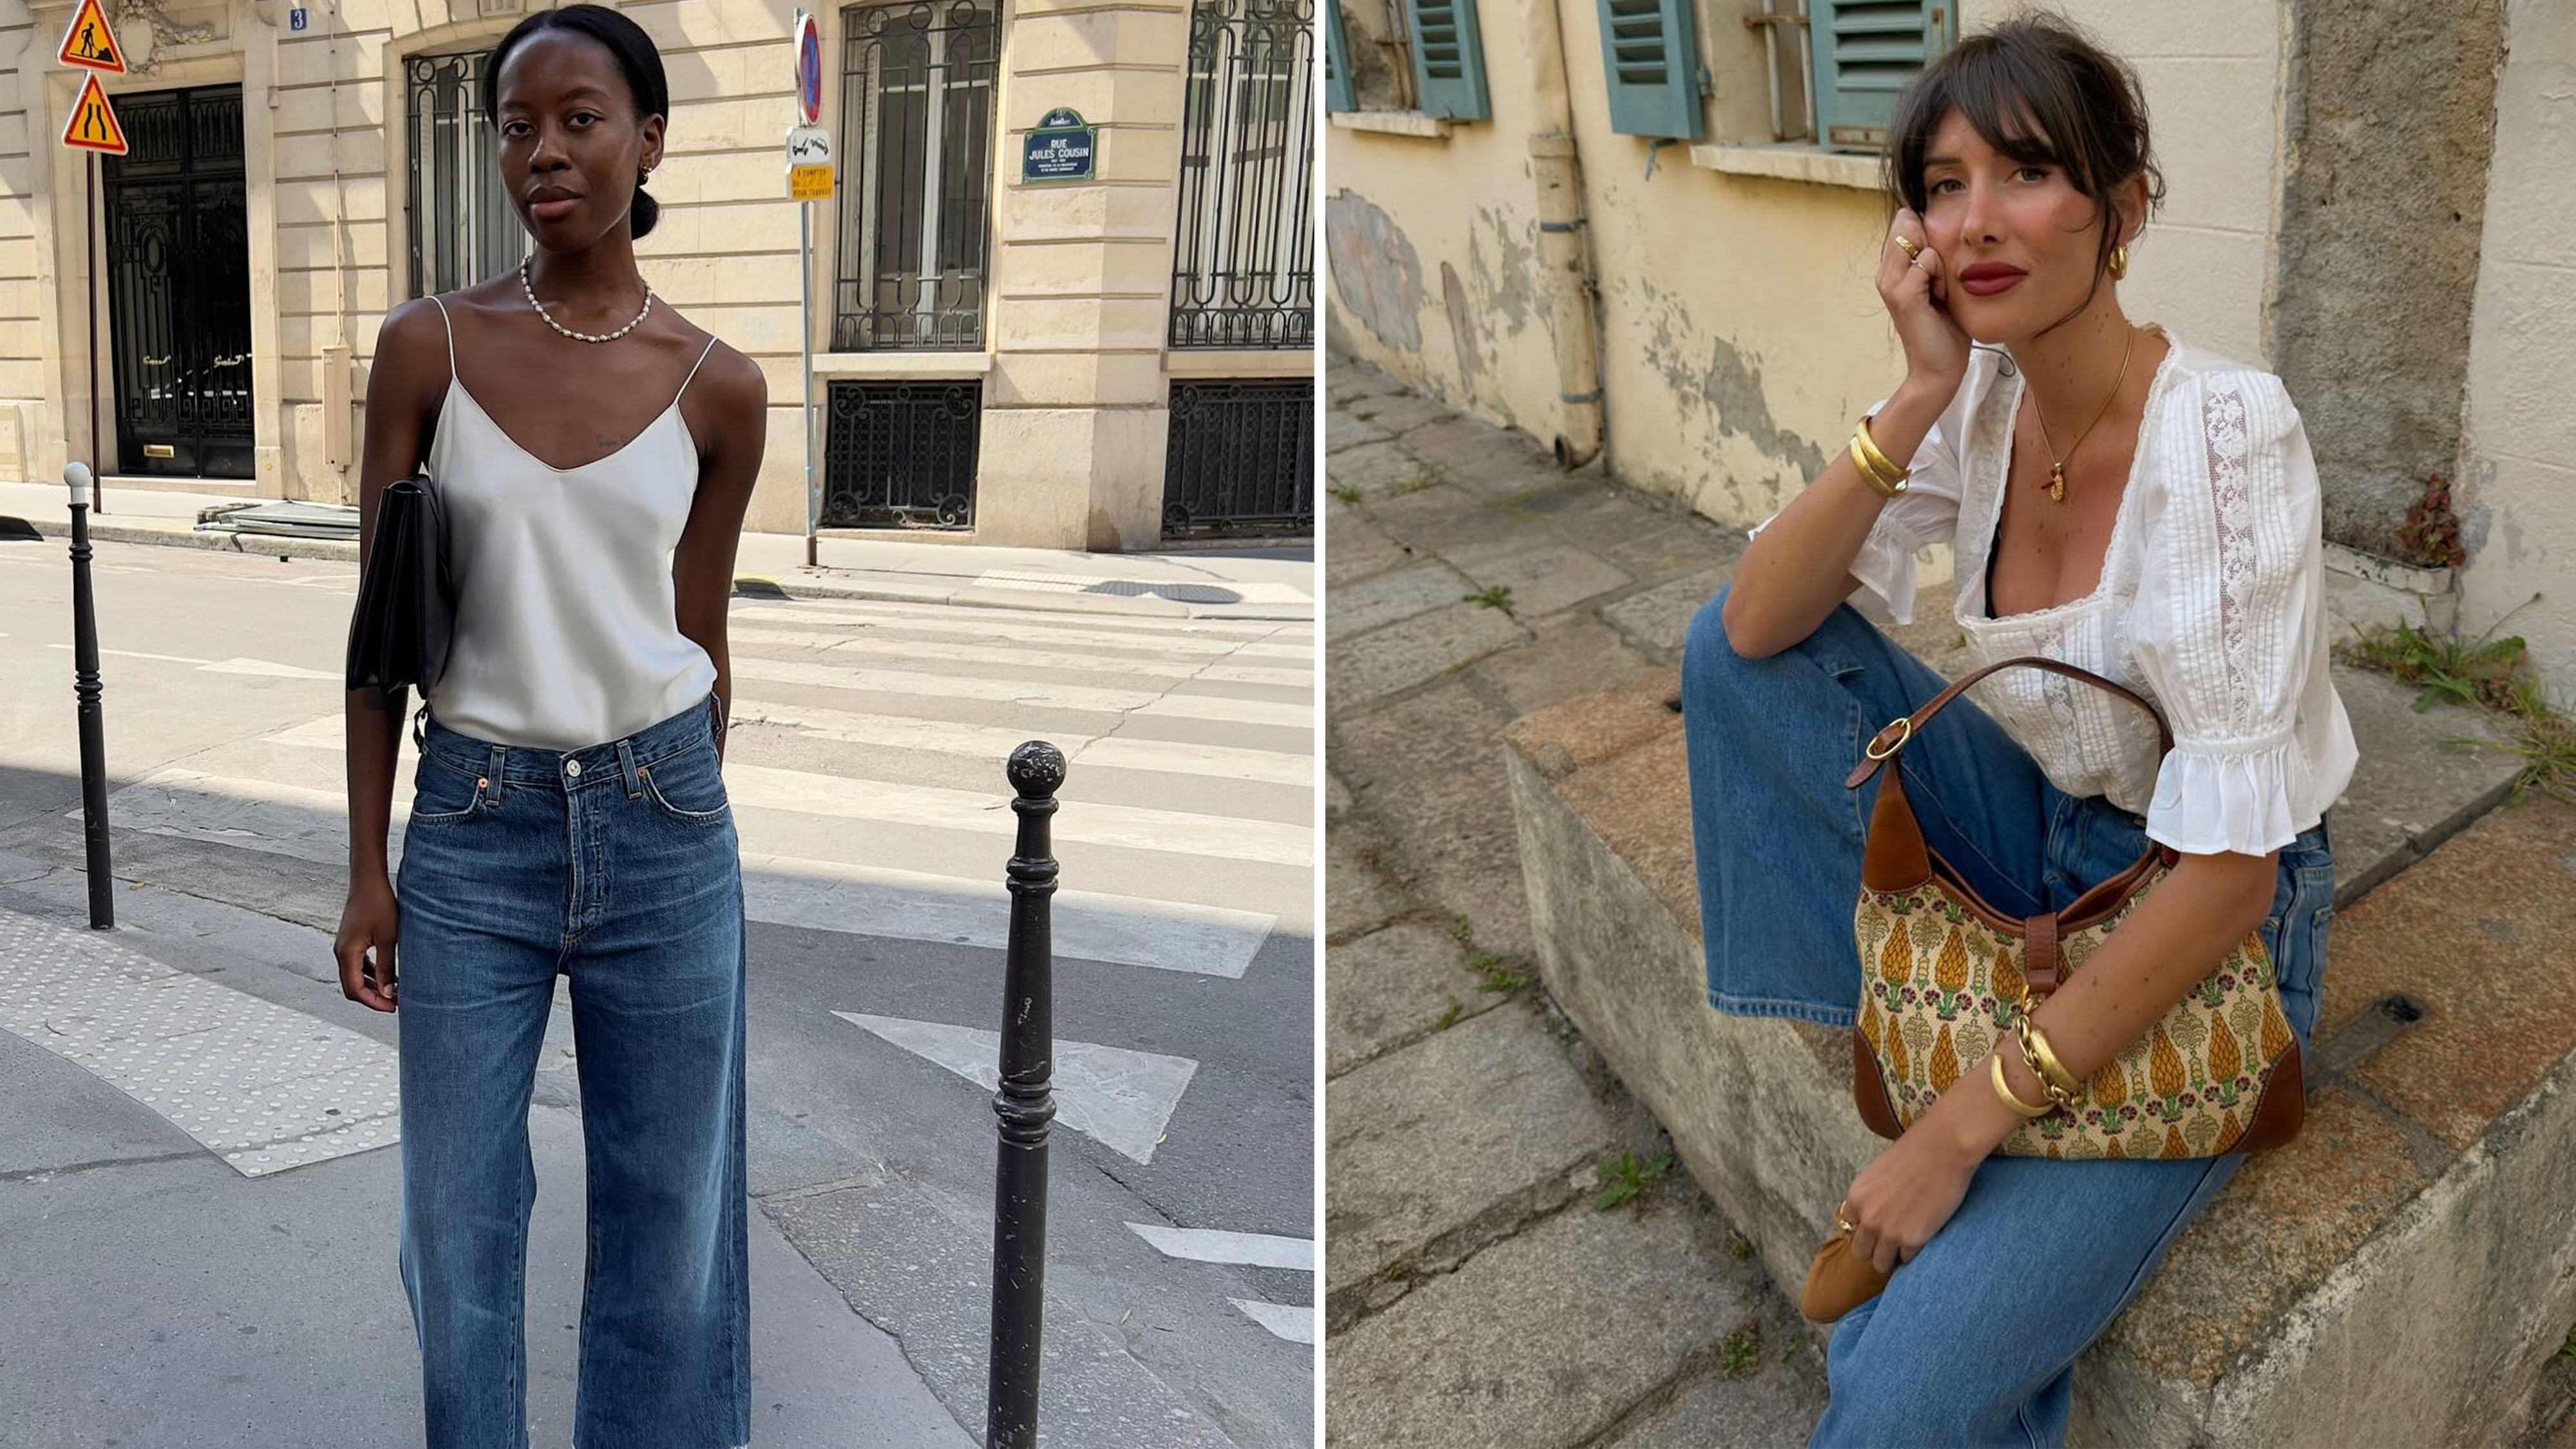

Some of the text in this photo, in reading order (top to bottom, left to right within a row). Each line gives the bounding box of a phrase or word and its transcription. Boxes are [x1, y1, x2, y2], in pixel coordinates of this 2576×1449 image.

[294, 11, 303, 28] 3
[1051, 139, 1067, 149] RUE
[1029, 149, 1055, 160] JULES
[1058, 147, 1089, 158] COUSIN
